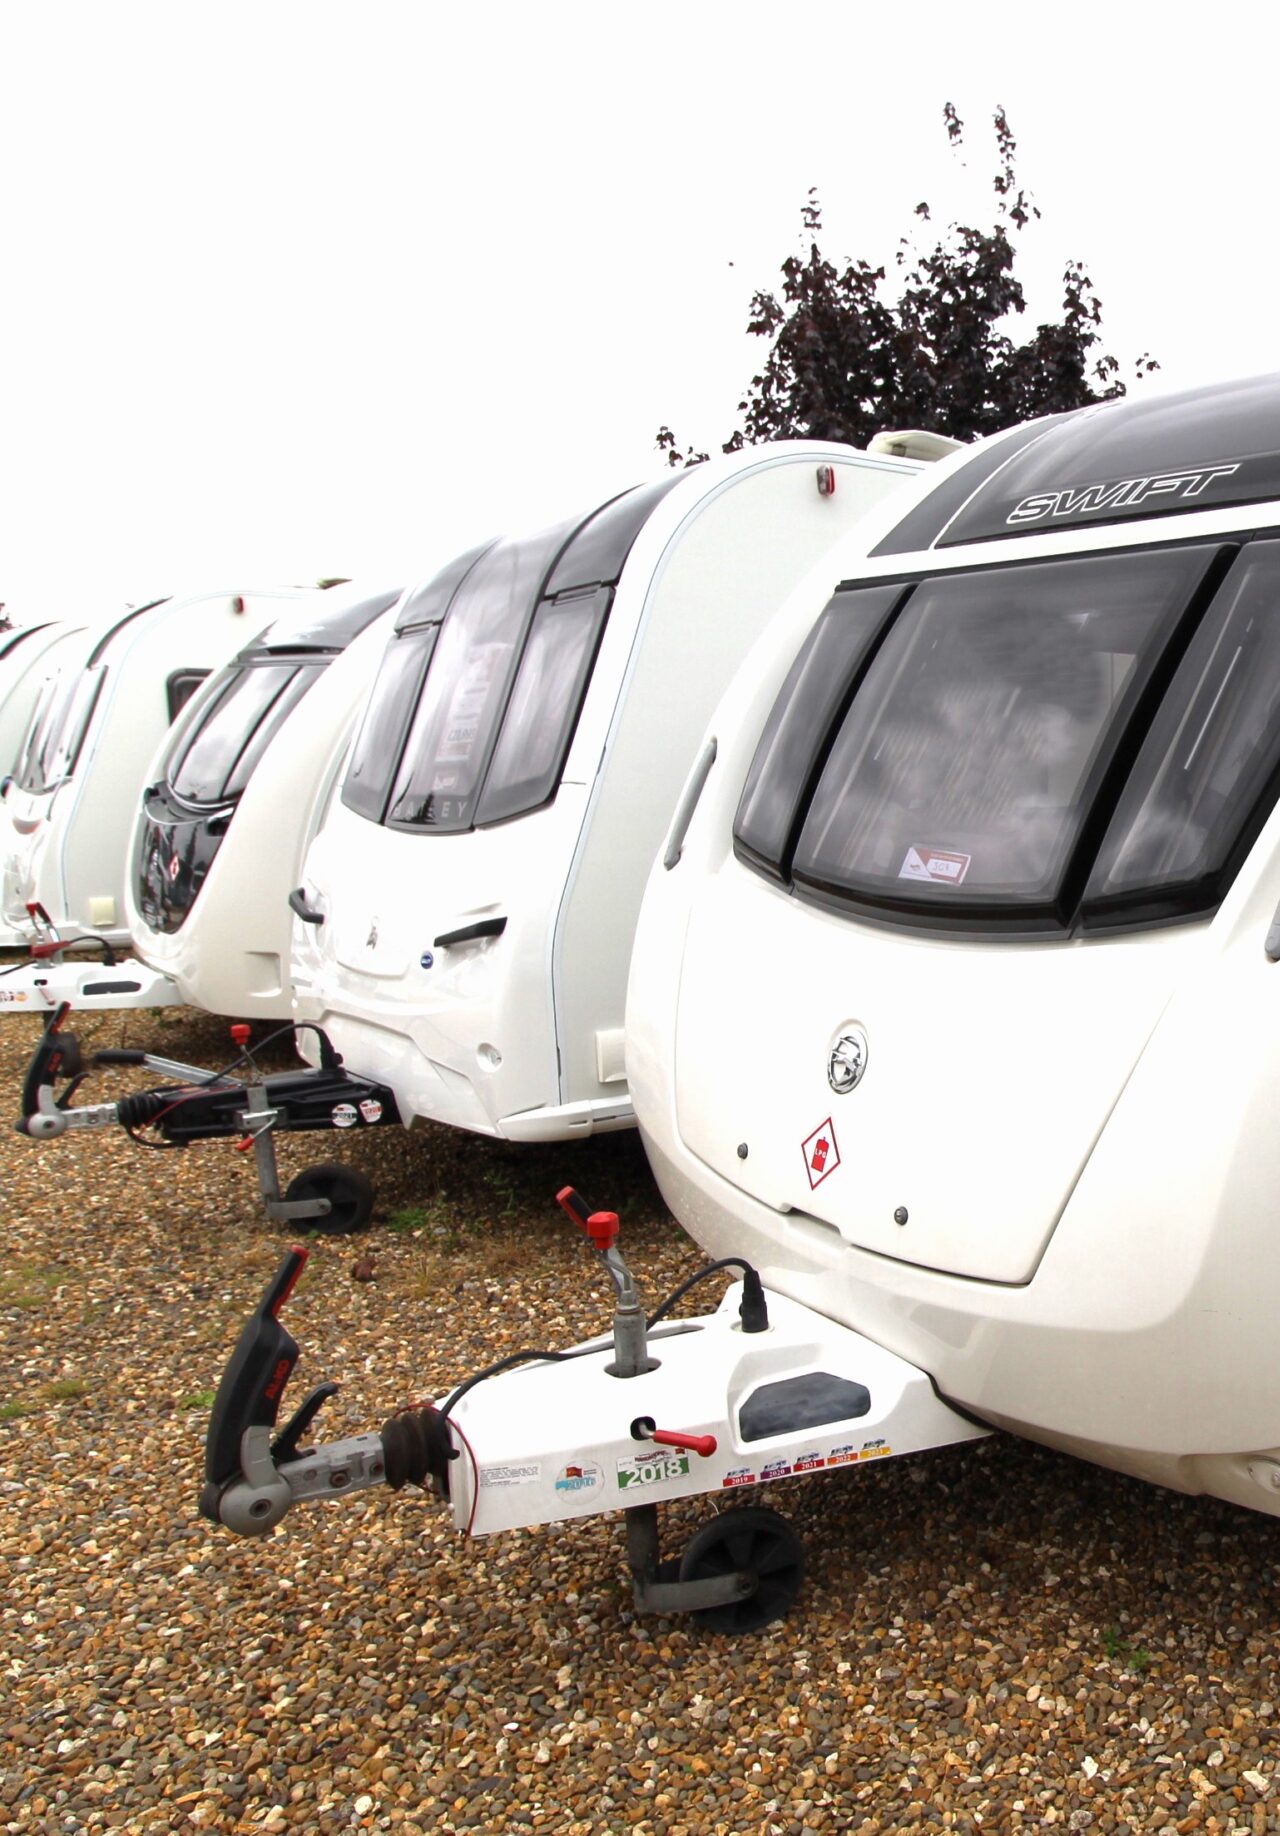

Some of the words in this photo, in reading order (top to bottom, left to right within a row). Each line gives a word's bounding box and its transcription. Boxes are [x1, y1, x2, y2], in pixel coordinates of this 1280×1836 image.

[1006, 463, 1241, 524] SWIFT
[625, 1458, 683, 1488] 2018
[769, 1468, 786, 1478] 2020
[801, 1461, 817, 1470] 2021
